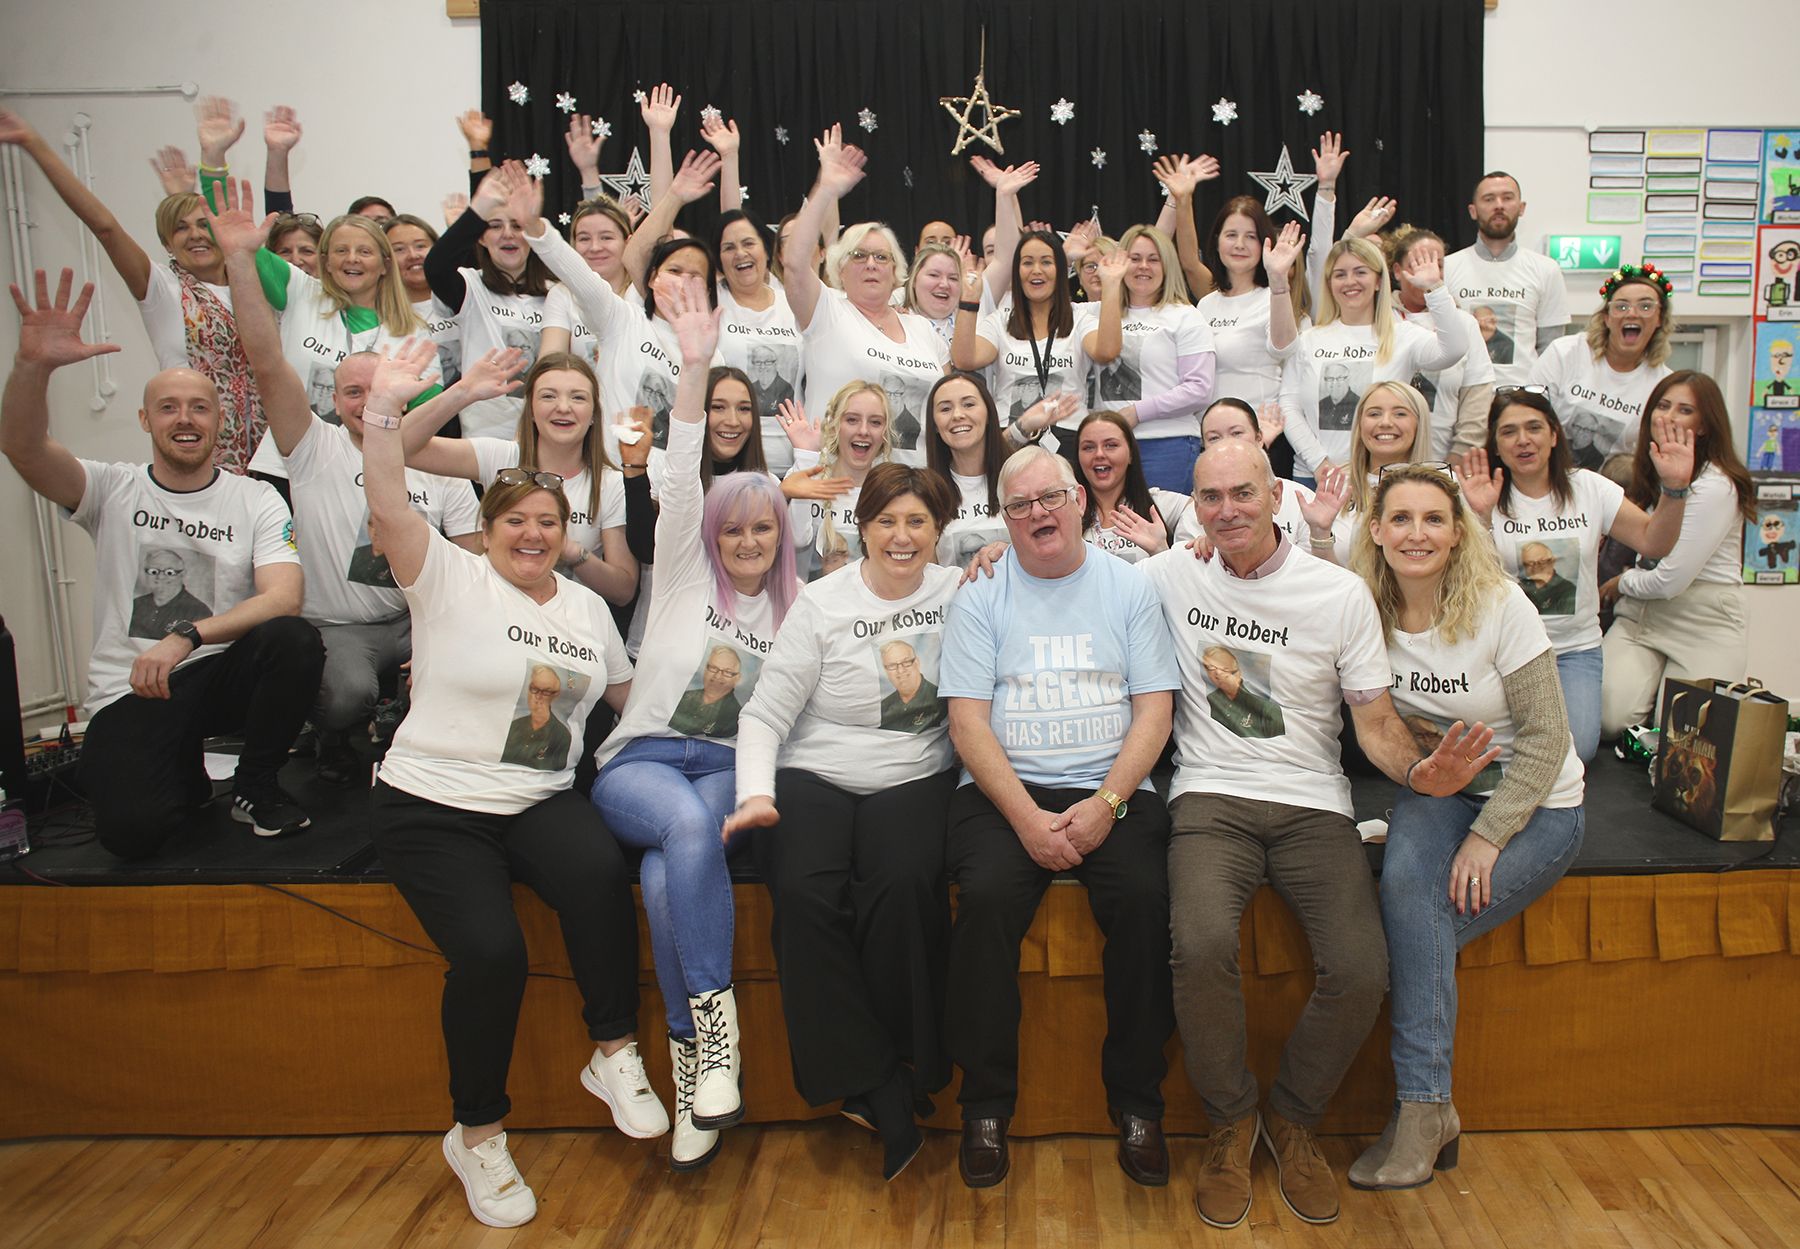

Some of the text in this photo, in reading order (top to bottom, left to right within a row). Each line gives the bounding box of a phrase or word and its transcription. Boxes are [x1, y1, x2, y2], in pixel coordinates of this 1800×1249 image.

[1459, 287, 1526, 299] Our Robert
[491, 305, 516, 318] Our
[727, 323, 751, 335] Our
[303, 336, 331, 357] Our
[640, 341, 667, 361] Our
[1314, 347, 1339, 359] Our
[866, 347, 939, 372] Our Robert
[1005, 352, 1029, 367] Our
[1570, 384, 1642, 416] Our Robert
[133, 509, 170, 530] Our
[1503, 512, 1588, 534] Our Robert
[853, 605, 945, 638] Our Robert
[1187, 607, 1289, 647] Our Robert
[507, 625, 542, 647] Our
[1028, 633, 1096, 670] THE
[1004, 671, 1124, 711] LEGEND
[1410, 671, 1469, 694] Robert
[1006, 713, 1124, 746] HAS RETIRED
